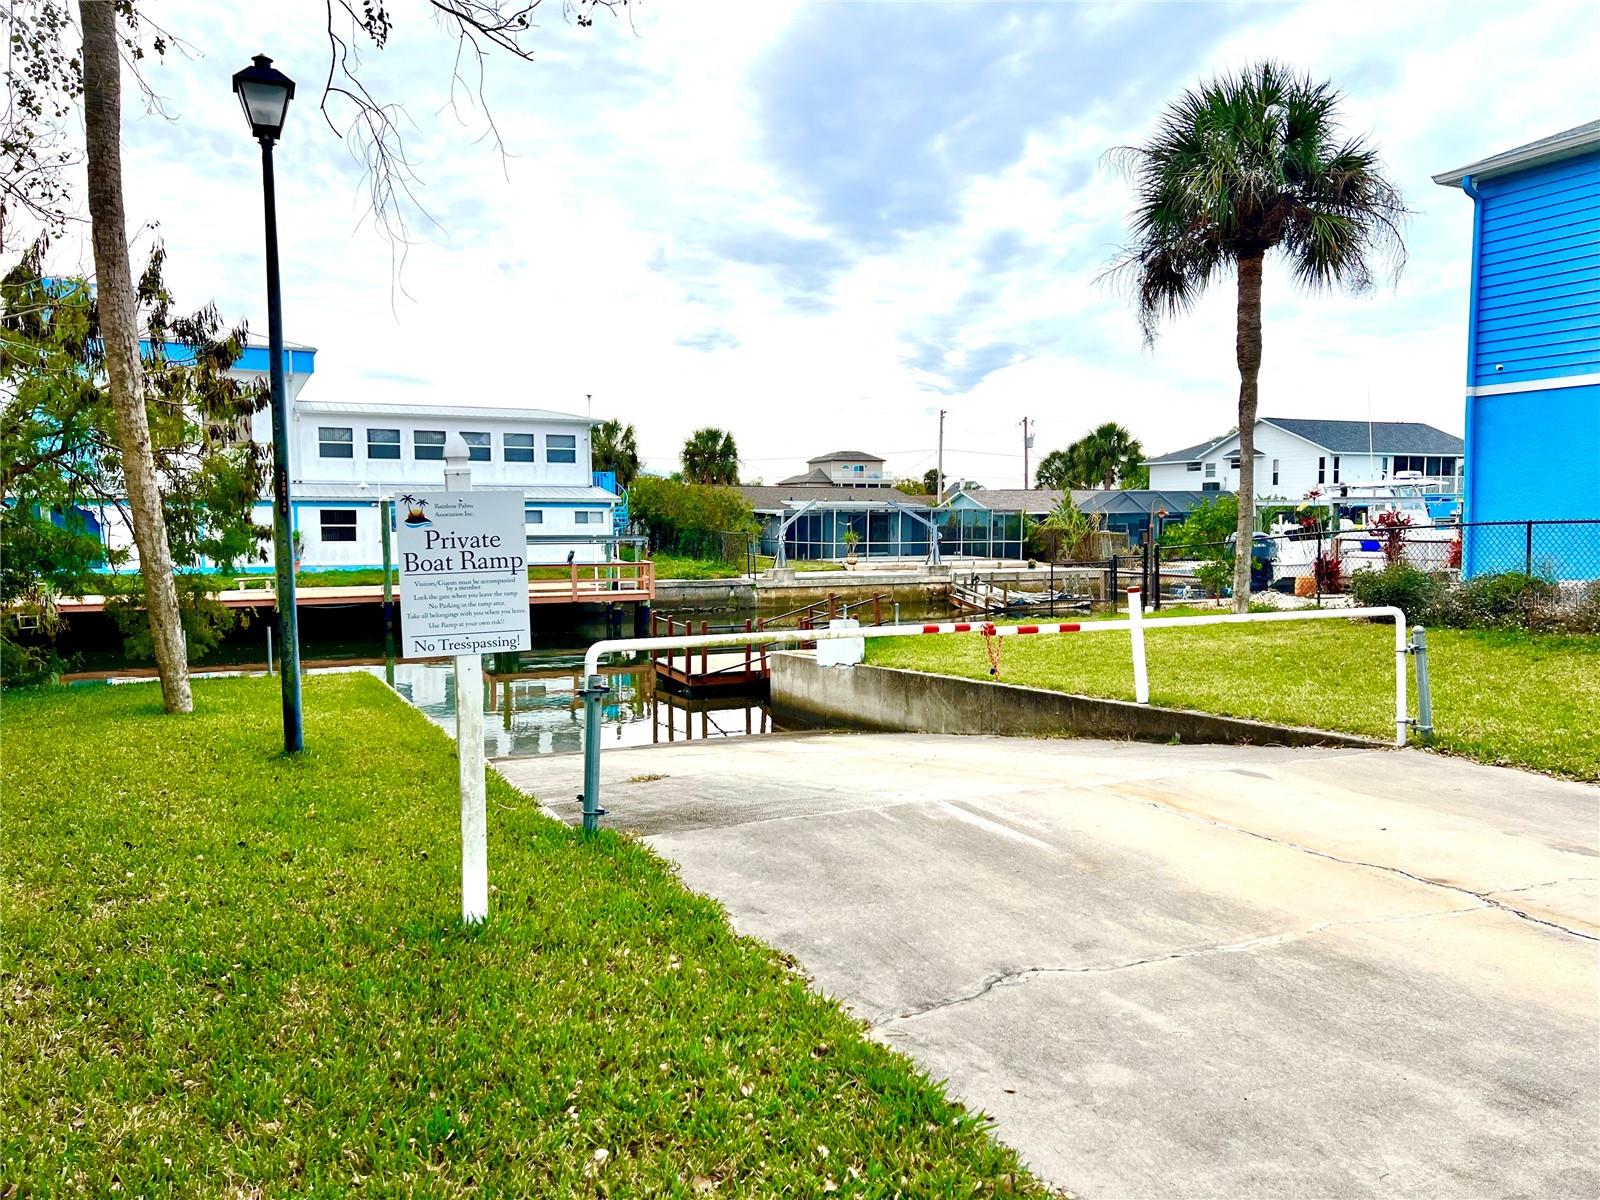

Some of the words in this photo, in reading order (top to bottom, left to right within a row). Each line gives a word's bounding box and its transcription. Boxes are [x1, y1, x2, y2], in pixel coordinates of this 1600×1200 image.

[424, 530, 502, 550] Private
[403, 552, 454, 572] Boat
[460, 550, 523, 576] Ramp
[414, 639, 435, 652] No
[438, 634, 520, 652] Tresspassing!
